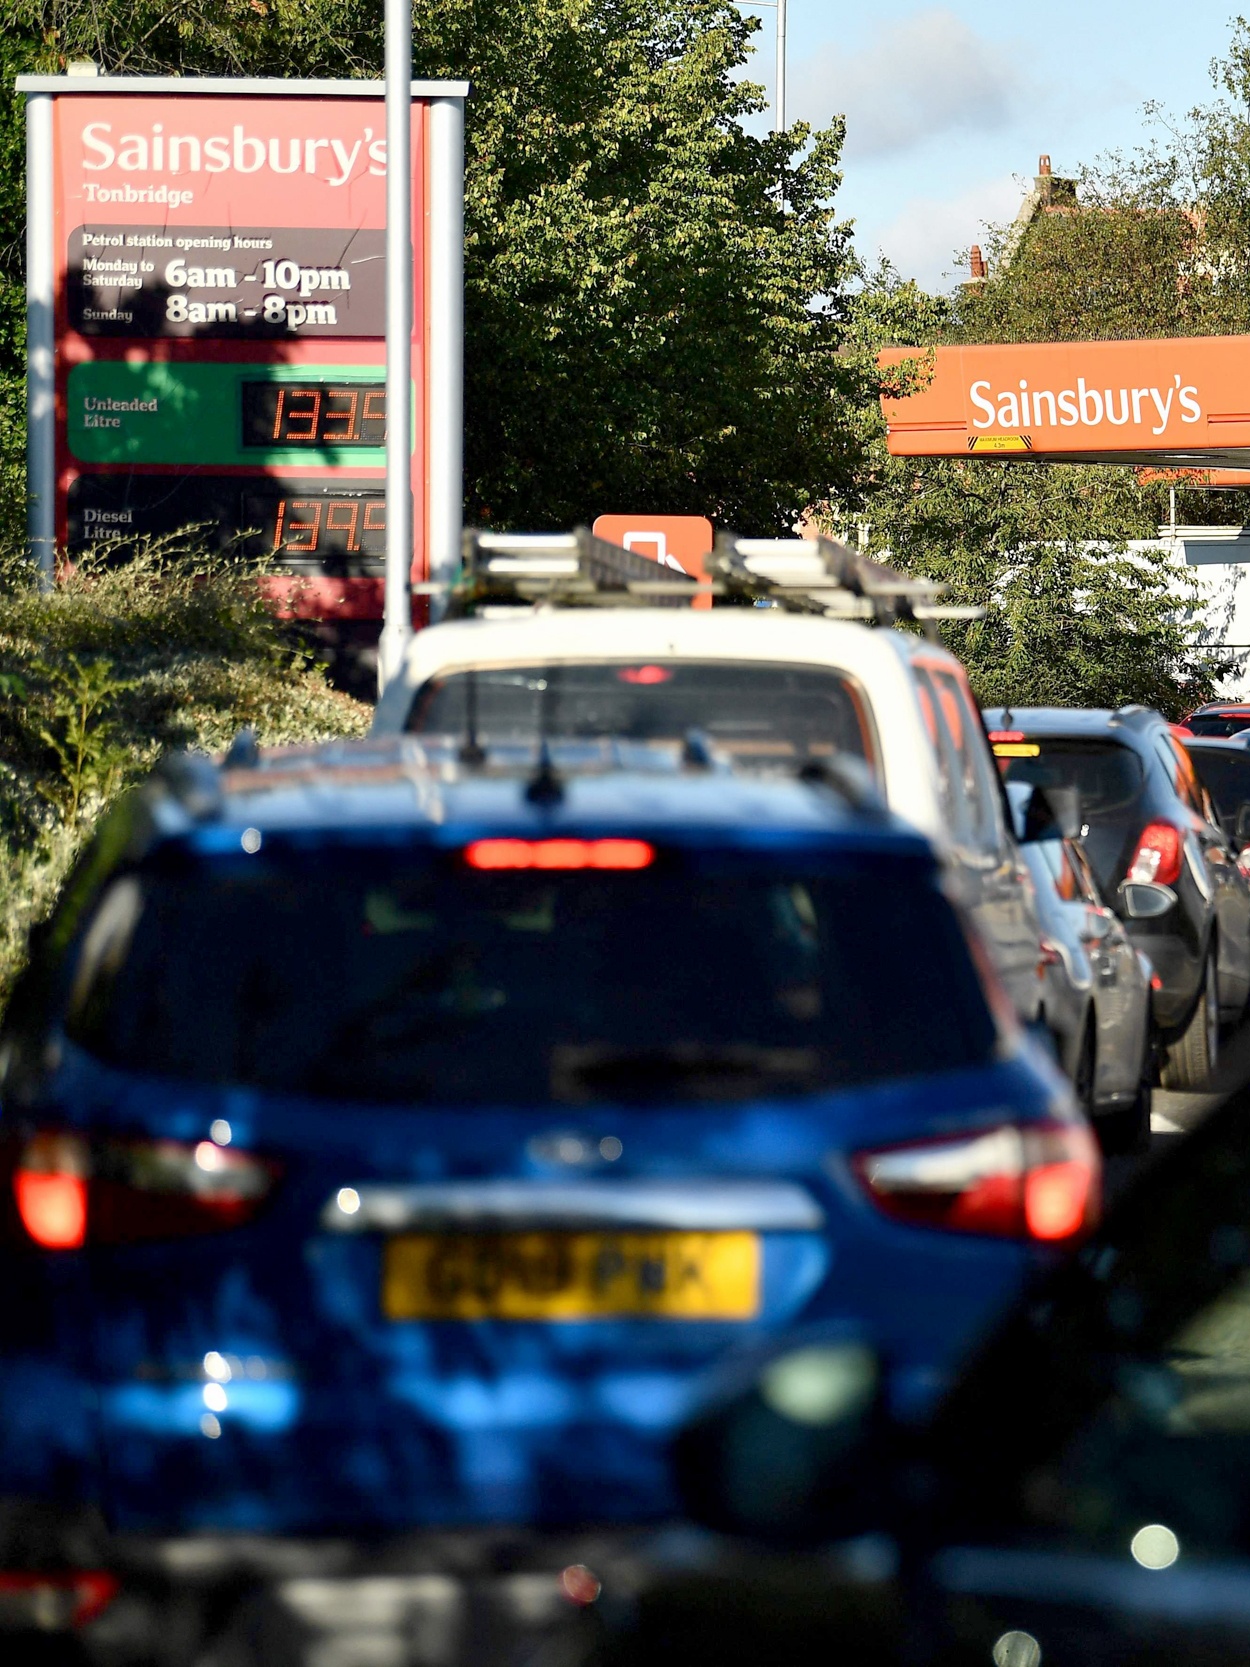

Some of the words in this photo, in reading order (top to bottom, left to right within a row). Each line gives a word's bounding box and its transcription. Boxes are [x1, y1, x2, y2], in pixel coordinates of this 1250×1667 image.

[81, 122, 388, 187] Sainsbury's
[83, 183, 194, 208] Tonbridge
[82, 233, 124, 247] Petrol
[126, 234, 173, 248] station
[176, 236, 231, 252] opening
[233, 236, 273, 250] hours
[82, 258, 138, 274] Monday
[140, 260, 154, 273] to
[82, 274, 143, 290] Saturday
[165, 259, 237, 289] 6am
[244, 274, 257, 282] -
[262, 260, 351, 297] 10pm
[82, 308, 134, 324] Sunday
[166, 294, 238, 323] 8am
[244, 309, 257, 317] -
[263, 295, 338, 331] 8pm
[83, 397, 158, 412] Unleaded
[969, 374, 1202, 435] Sainsbury's
[83, 413, 121, 428] Litre
[83, 508, 133, 523] Diesel
[83, 525, 121, 540] Litre
